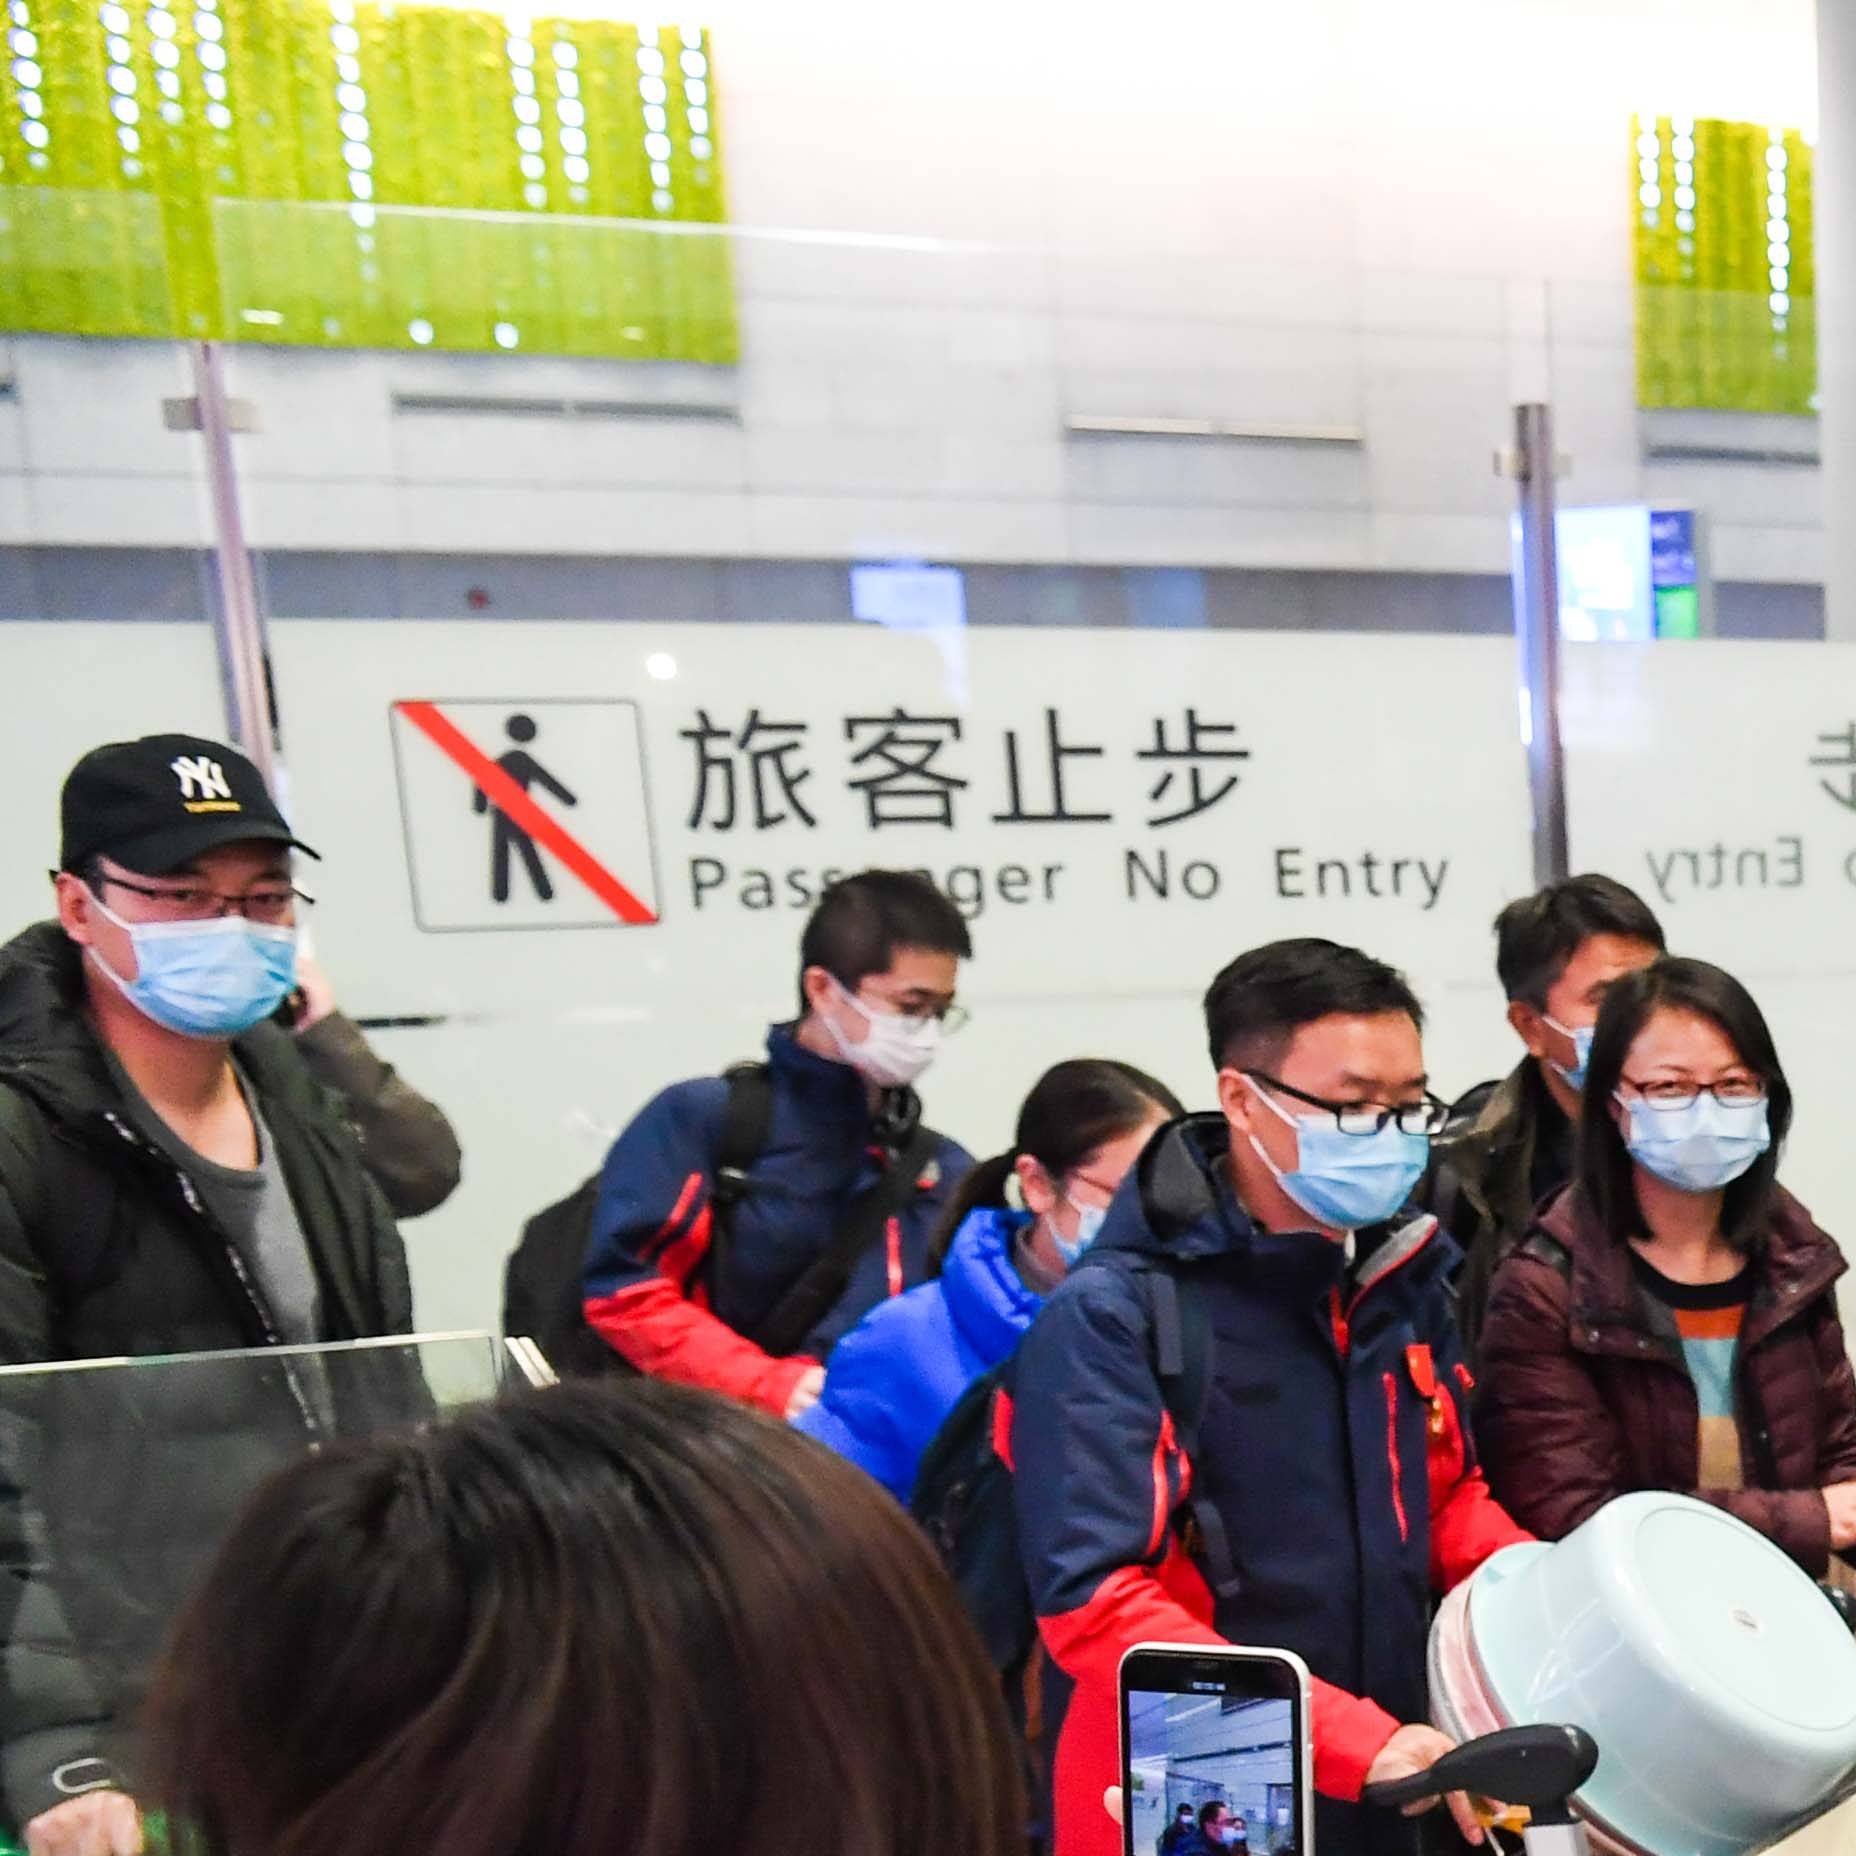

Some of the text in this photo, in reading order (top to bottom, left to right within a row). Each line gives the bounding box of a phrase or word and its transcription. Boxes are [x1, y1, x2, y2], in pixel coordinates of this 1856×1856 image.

[679, 706, 1251, 832] 旅客止步
[689, 845, 1449, 920] Pasger No Entry
